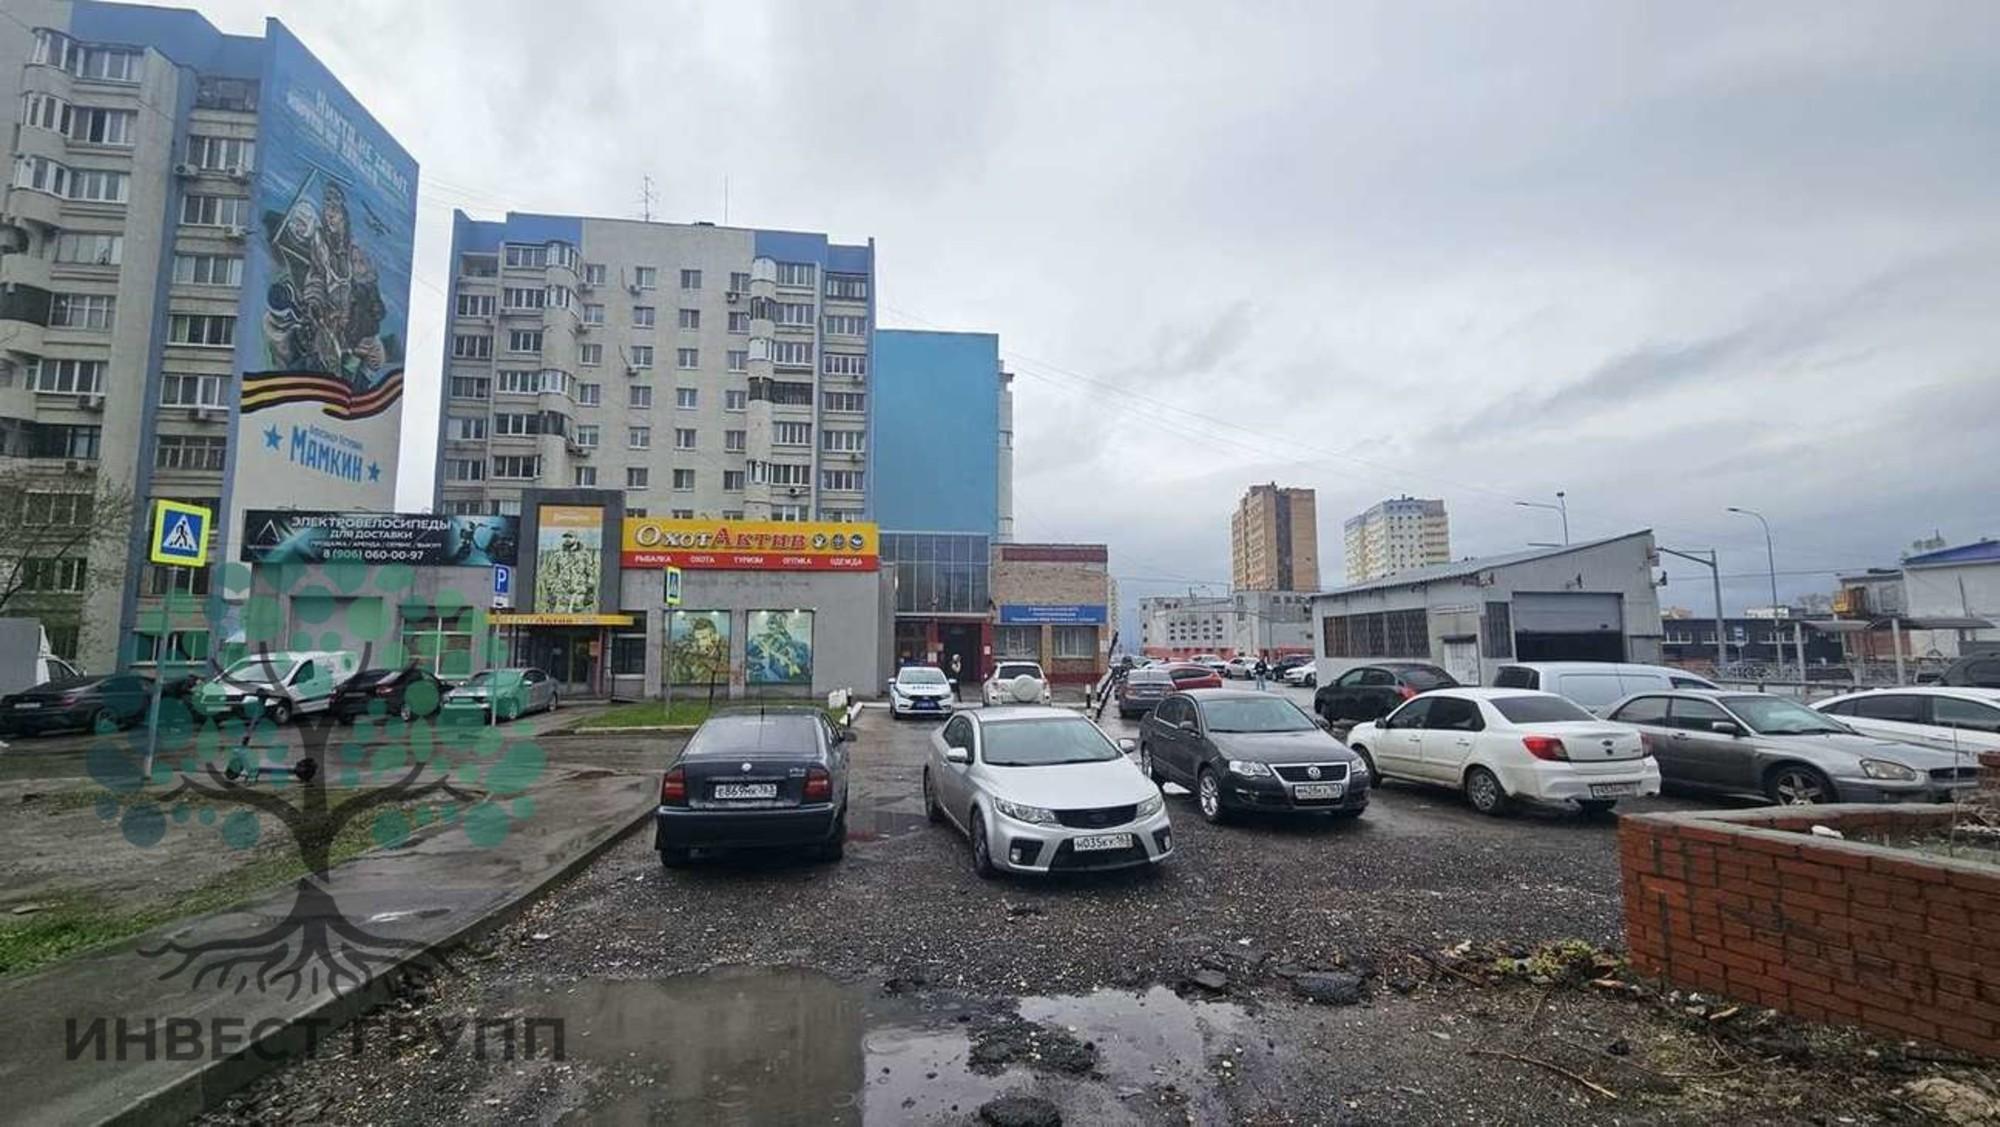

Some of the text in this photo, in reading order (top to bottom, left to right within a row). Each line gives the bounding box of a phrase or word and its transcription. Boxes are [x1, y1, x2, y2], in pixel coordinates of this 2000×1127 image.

[291, 516, 451, 531] ЭЛЕКТРОВЕЛОСИПЕДЫ
[330, 531, 413, 540] ДЛЯ ДОСТАВКИ
[323, 549, 424, 560] 8 (906) 060-00-97
[635, 554, 863, 566] РЫБАЛКА ОХОТА ТУРИЗМ ОПТИКА ОДЕЖДА
